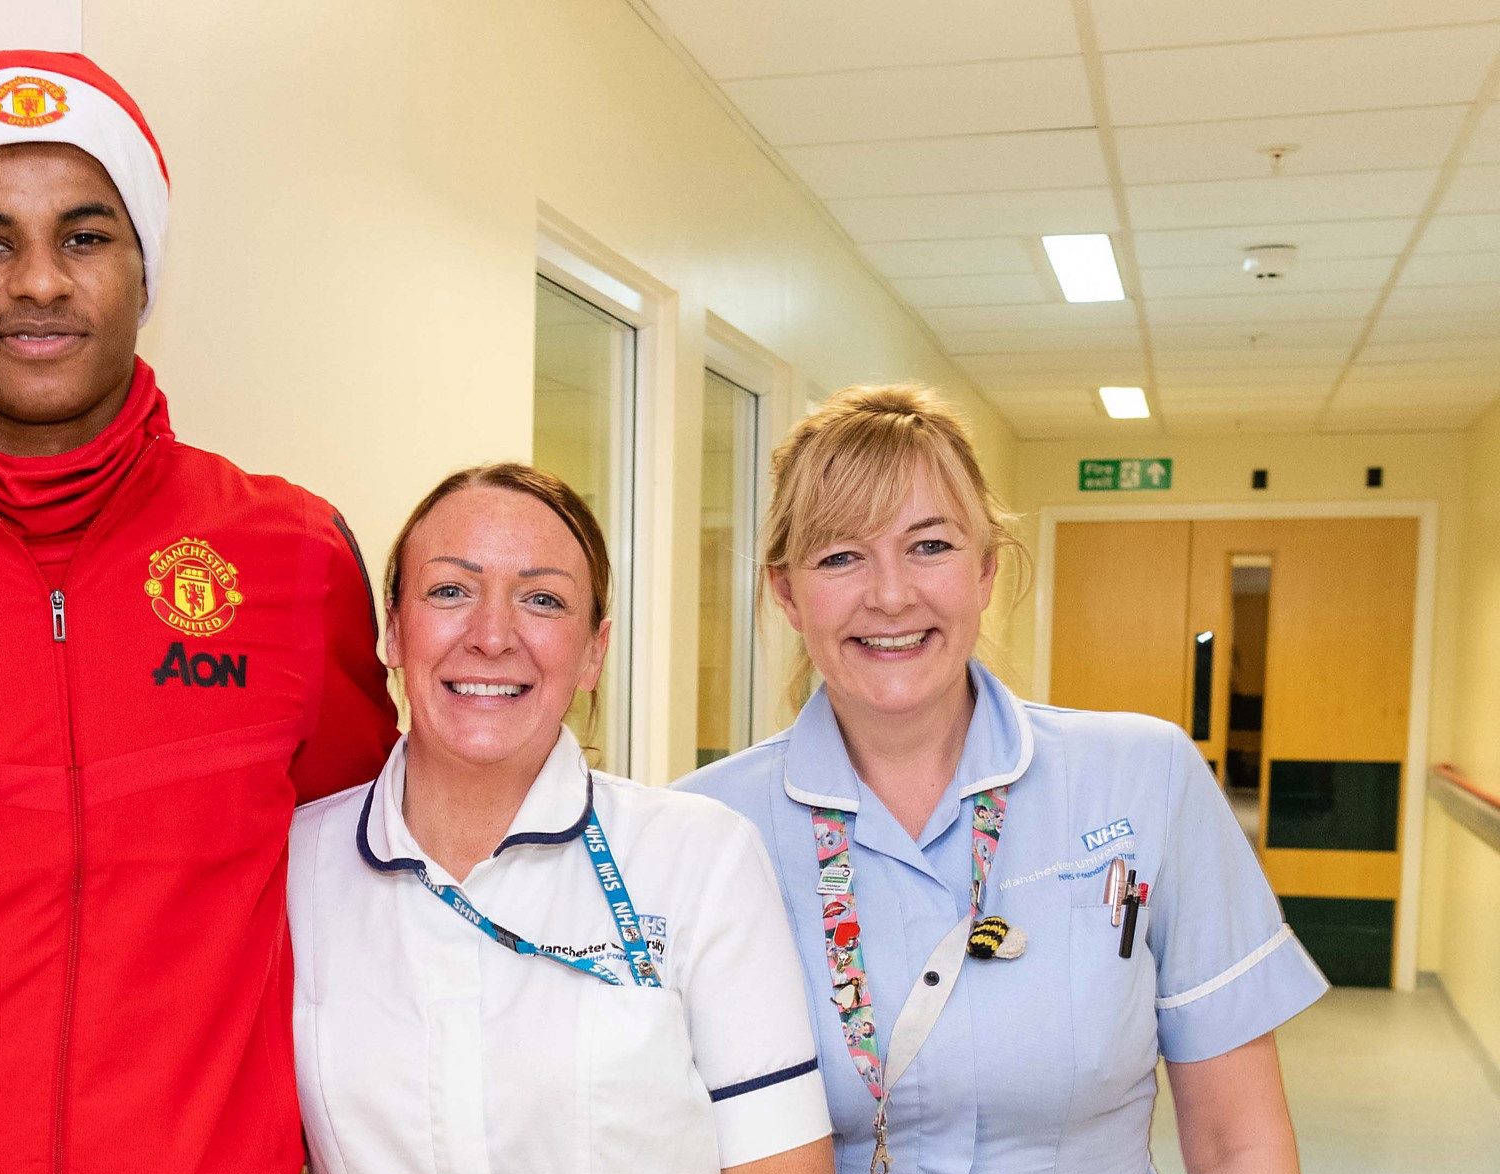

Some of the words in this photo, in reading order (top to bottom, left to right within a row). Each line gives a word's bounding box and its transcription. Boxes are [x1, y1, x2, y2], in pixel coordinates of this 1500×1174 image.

[156, 545, 231, 584] MANCHESTER
[168, 612, 223, 632] UNITED
[585, 824, 606, 854] NHS
[1085, 819, 1130, 850] NHS
[596, 862, 623, 892] NHS
[999, 860, 1073, 891] Manchester
[1076, 838, 1135, 869] University
[453, 897, 481, 925] NHS
[612, 901, 635, 929] NH
